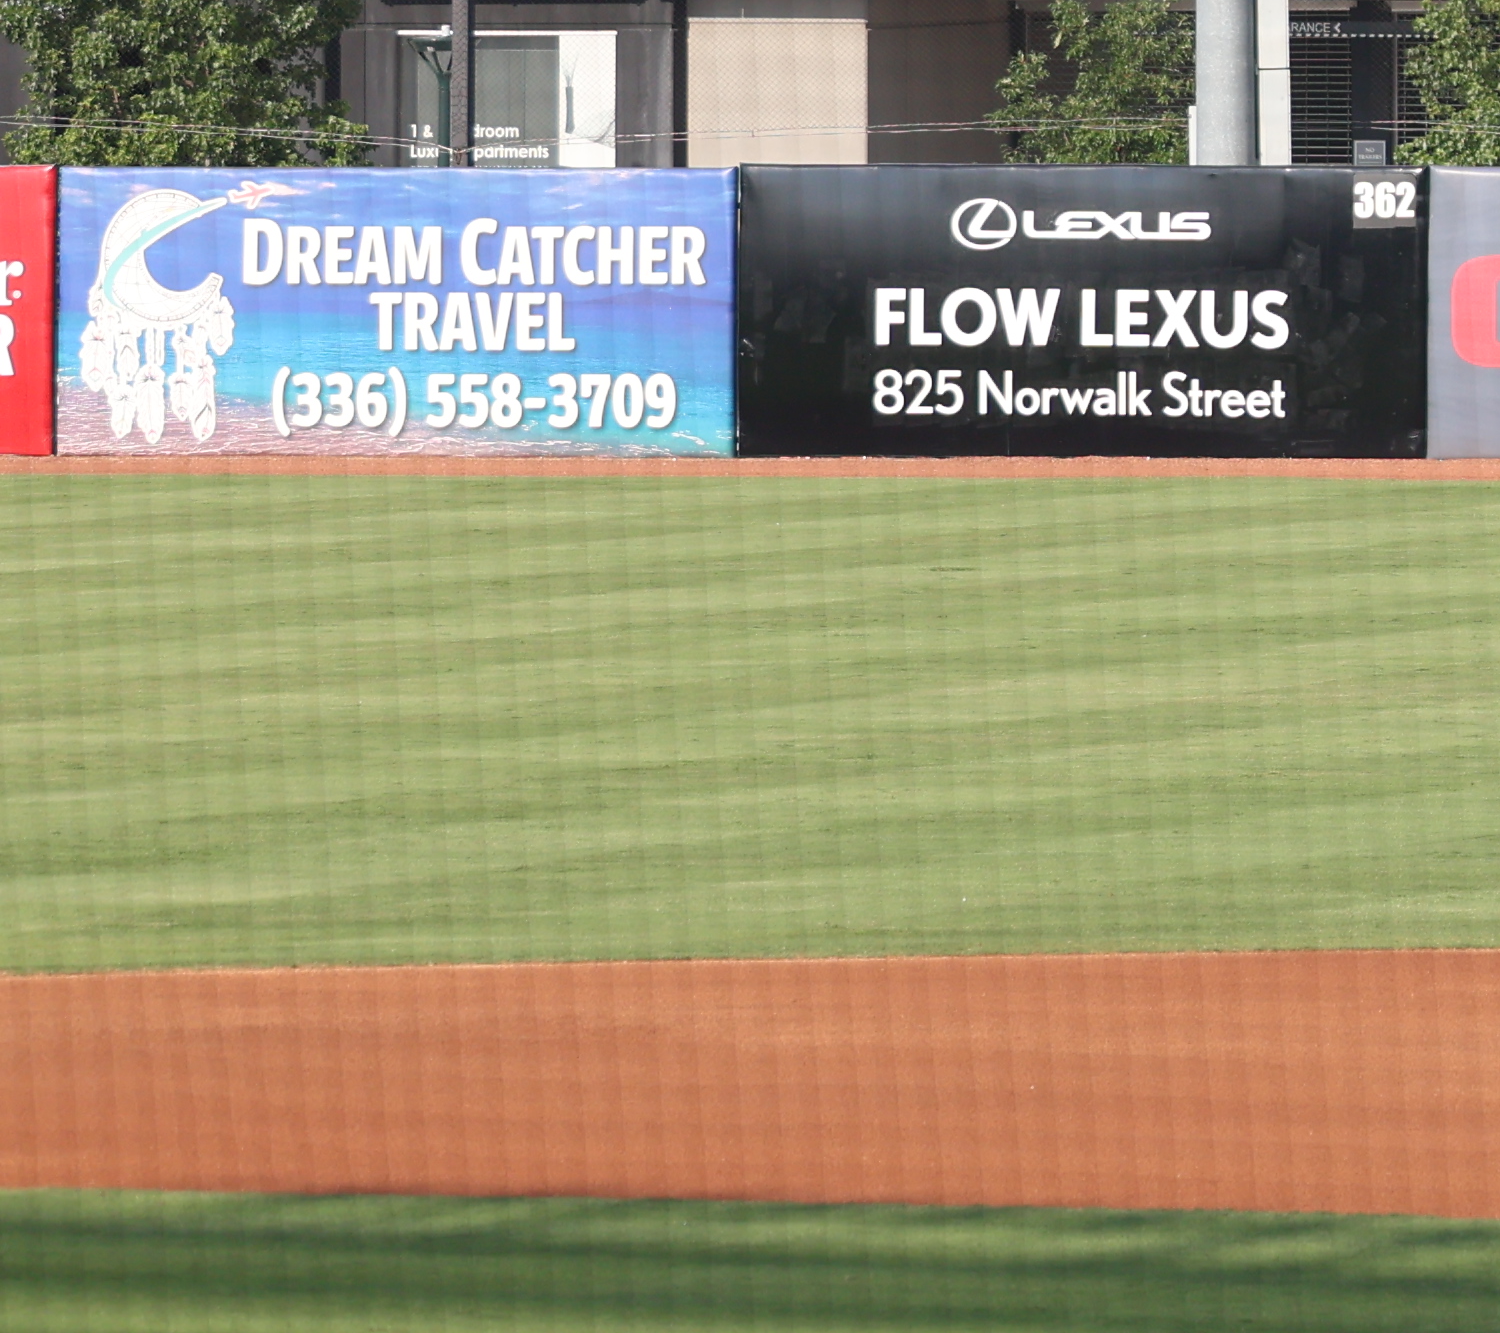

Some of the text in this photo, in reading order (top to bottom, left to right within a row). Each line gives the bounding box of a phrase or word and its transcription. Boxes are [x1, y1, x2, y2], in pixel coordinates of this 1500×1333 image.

[1289, 22, 1331, 32] RANCE
[410, 124, 417, 138] 1
[423, 125, 433, 138] &
[410, 145, 549, 161] Lux partments
[1354, 181, 1416, 219] 362
[1024, 211, 1211, 241] LEXUS
[242, 219, 706, 286] DREAM CATCHER
[370, 292, 575, 351] TRAVEL
[875, 288, 1288, 349] FLOW LEXUS
[272, 367, 677, 435] (336) 558-3709
[873, 369, 1285, 418] 825 Norwalk Street
